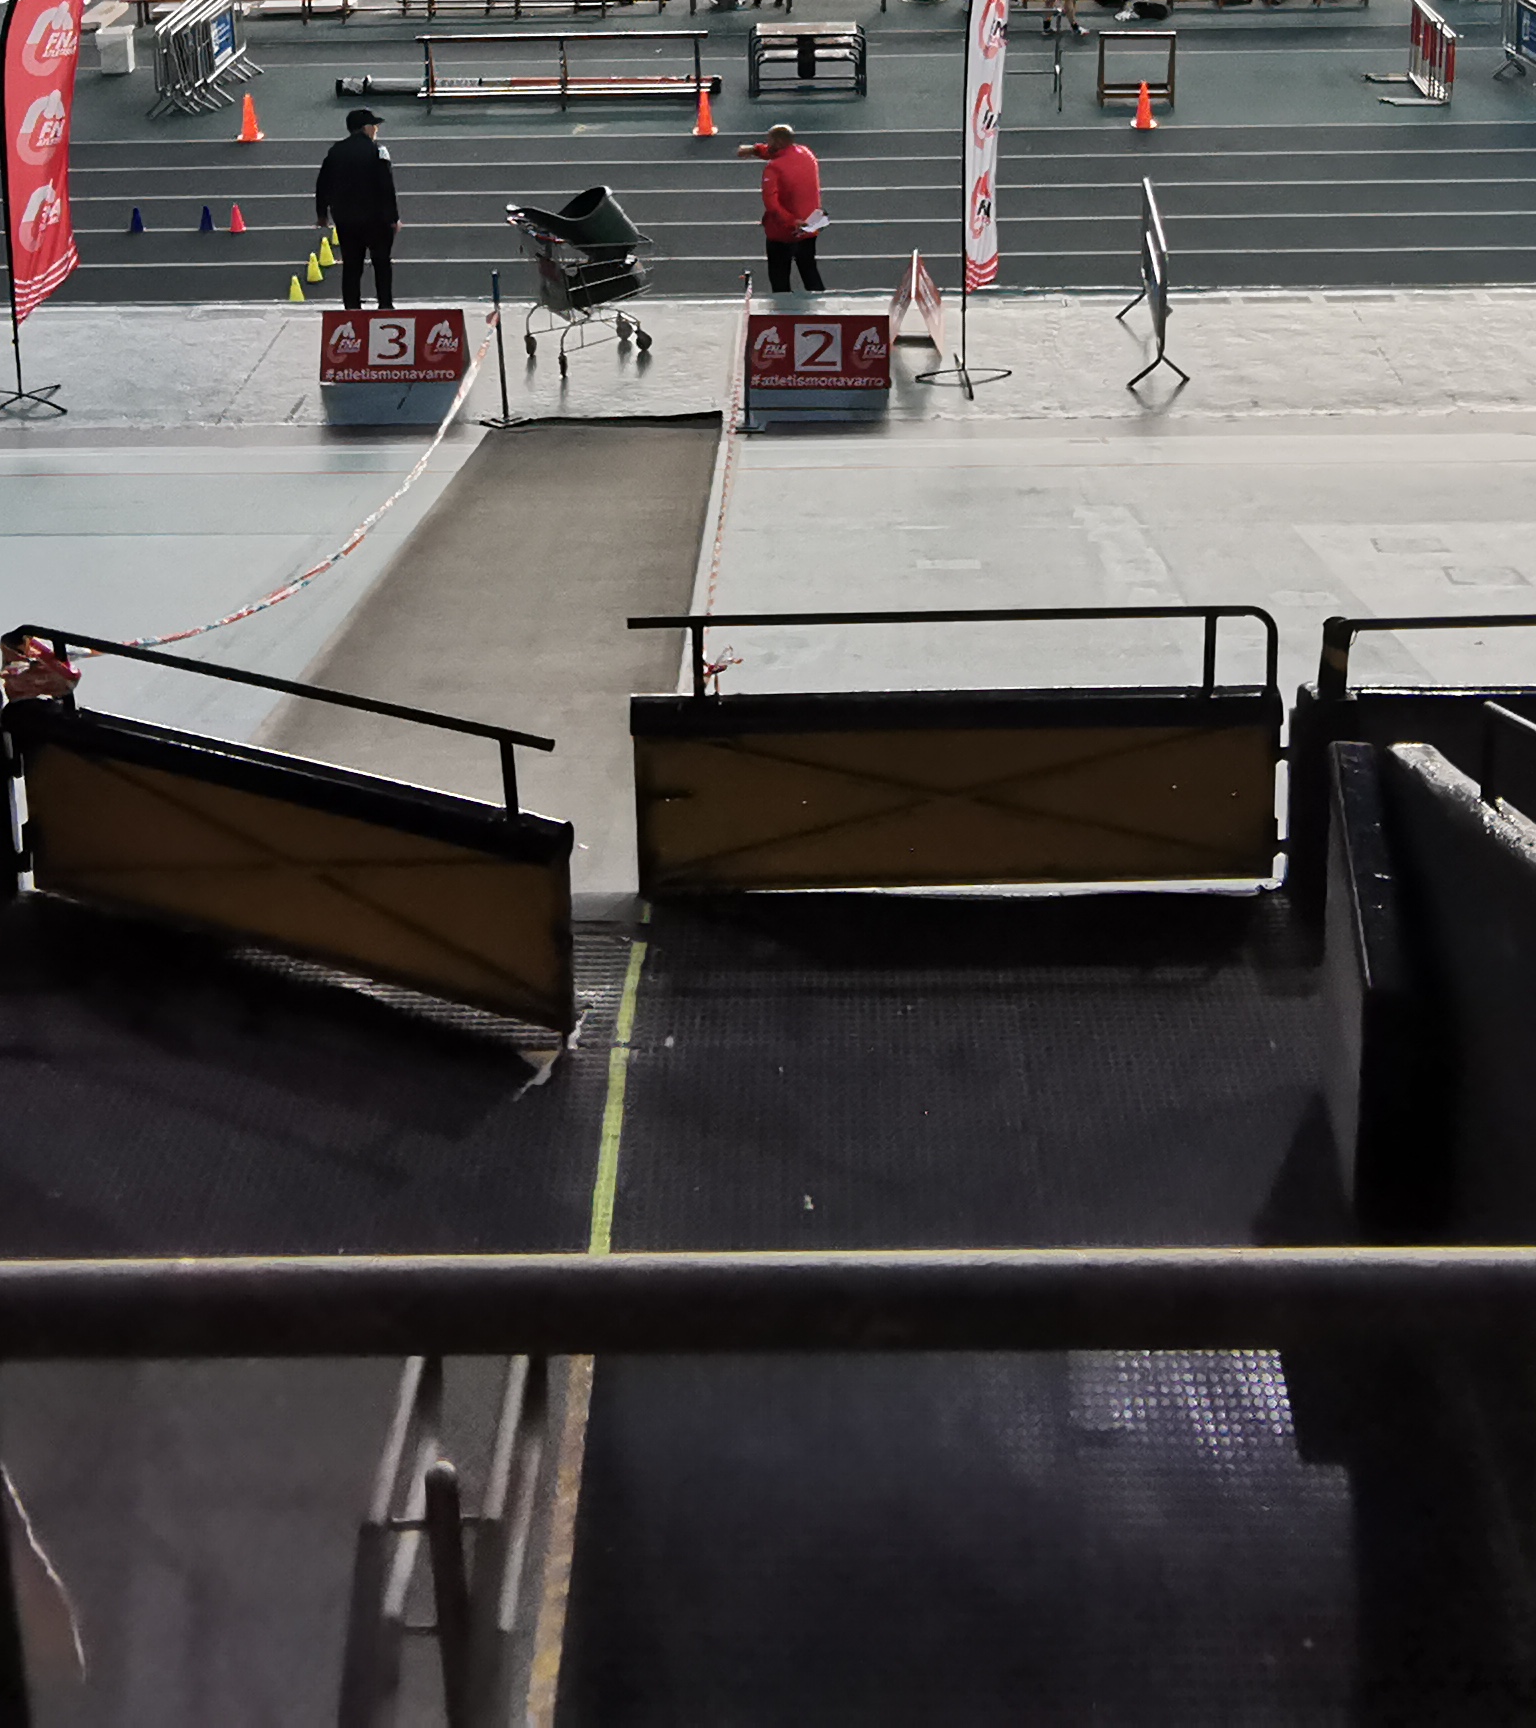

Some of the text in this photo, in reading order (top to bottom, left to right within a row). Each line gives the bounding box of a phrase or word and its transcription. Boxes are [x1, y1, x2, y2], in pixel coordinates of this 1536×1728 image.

[377, 324, 408, 359] 3
[801, 330, 837, 366] 2
[325, 368, 456, 380] #atletismonavarro
[750, 374, 884, 387] #atletismonavarro
